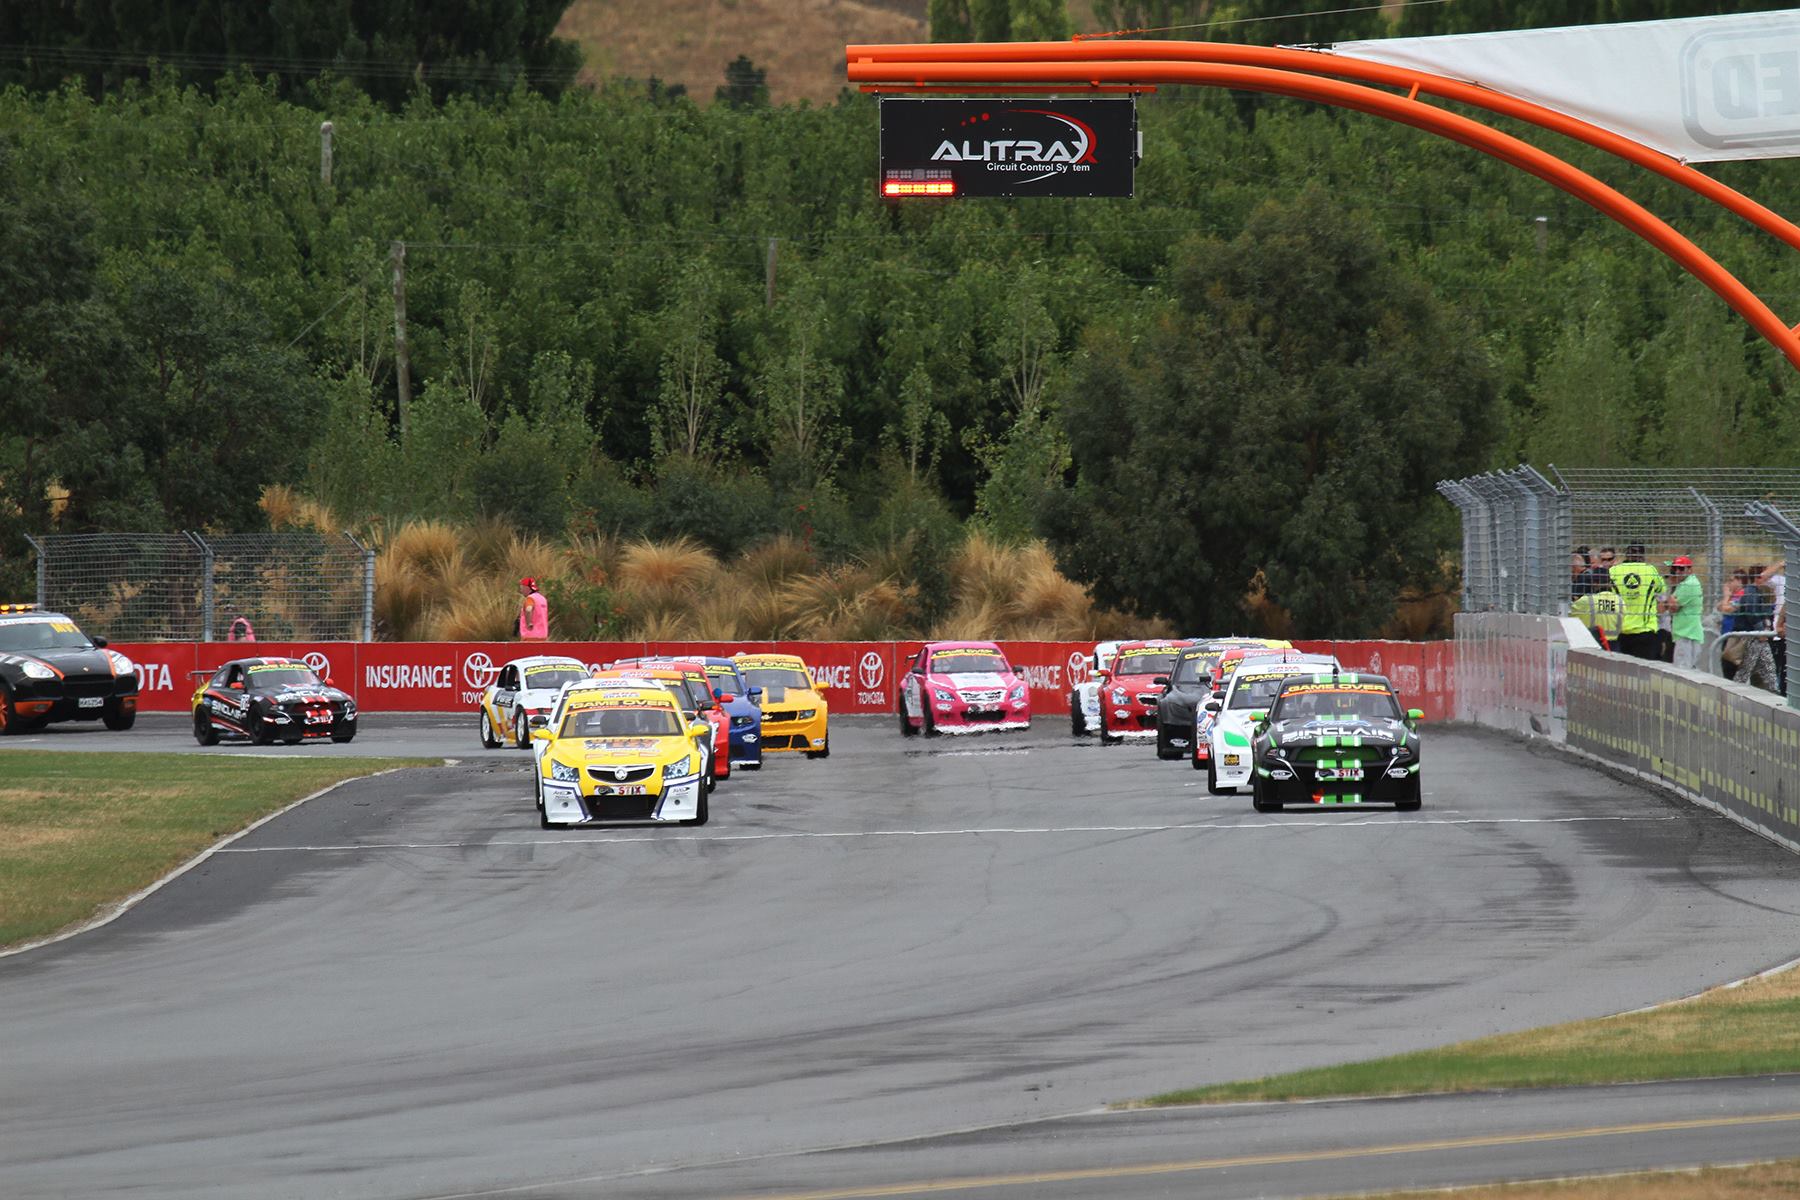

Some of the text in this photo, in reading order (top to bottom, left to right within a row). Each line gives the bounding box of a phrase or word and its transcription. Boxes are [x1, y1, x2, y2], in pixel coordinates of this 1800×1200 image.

[986, 163, 1017, 172] Circuit
[1019, 163, 1053, 172] Control
[1597, 599, 1616, 613] FIRE
[366, 665, 453, 689] INSURANCE
[1245, 674, 1285, 682] GAME
[1288, 683, 1387, 693] GAME OVER
[857, 692, 886, 705] TOYOTA
[572, 699, 670, 709] GAME OVER
[1282, 727, 1395, 741] SINCLAIR
[1338, 768, 1360, 777] STIX
[617, 786, 642, 795] STIX
